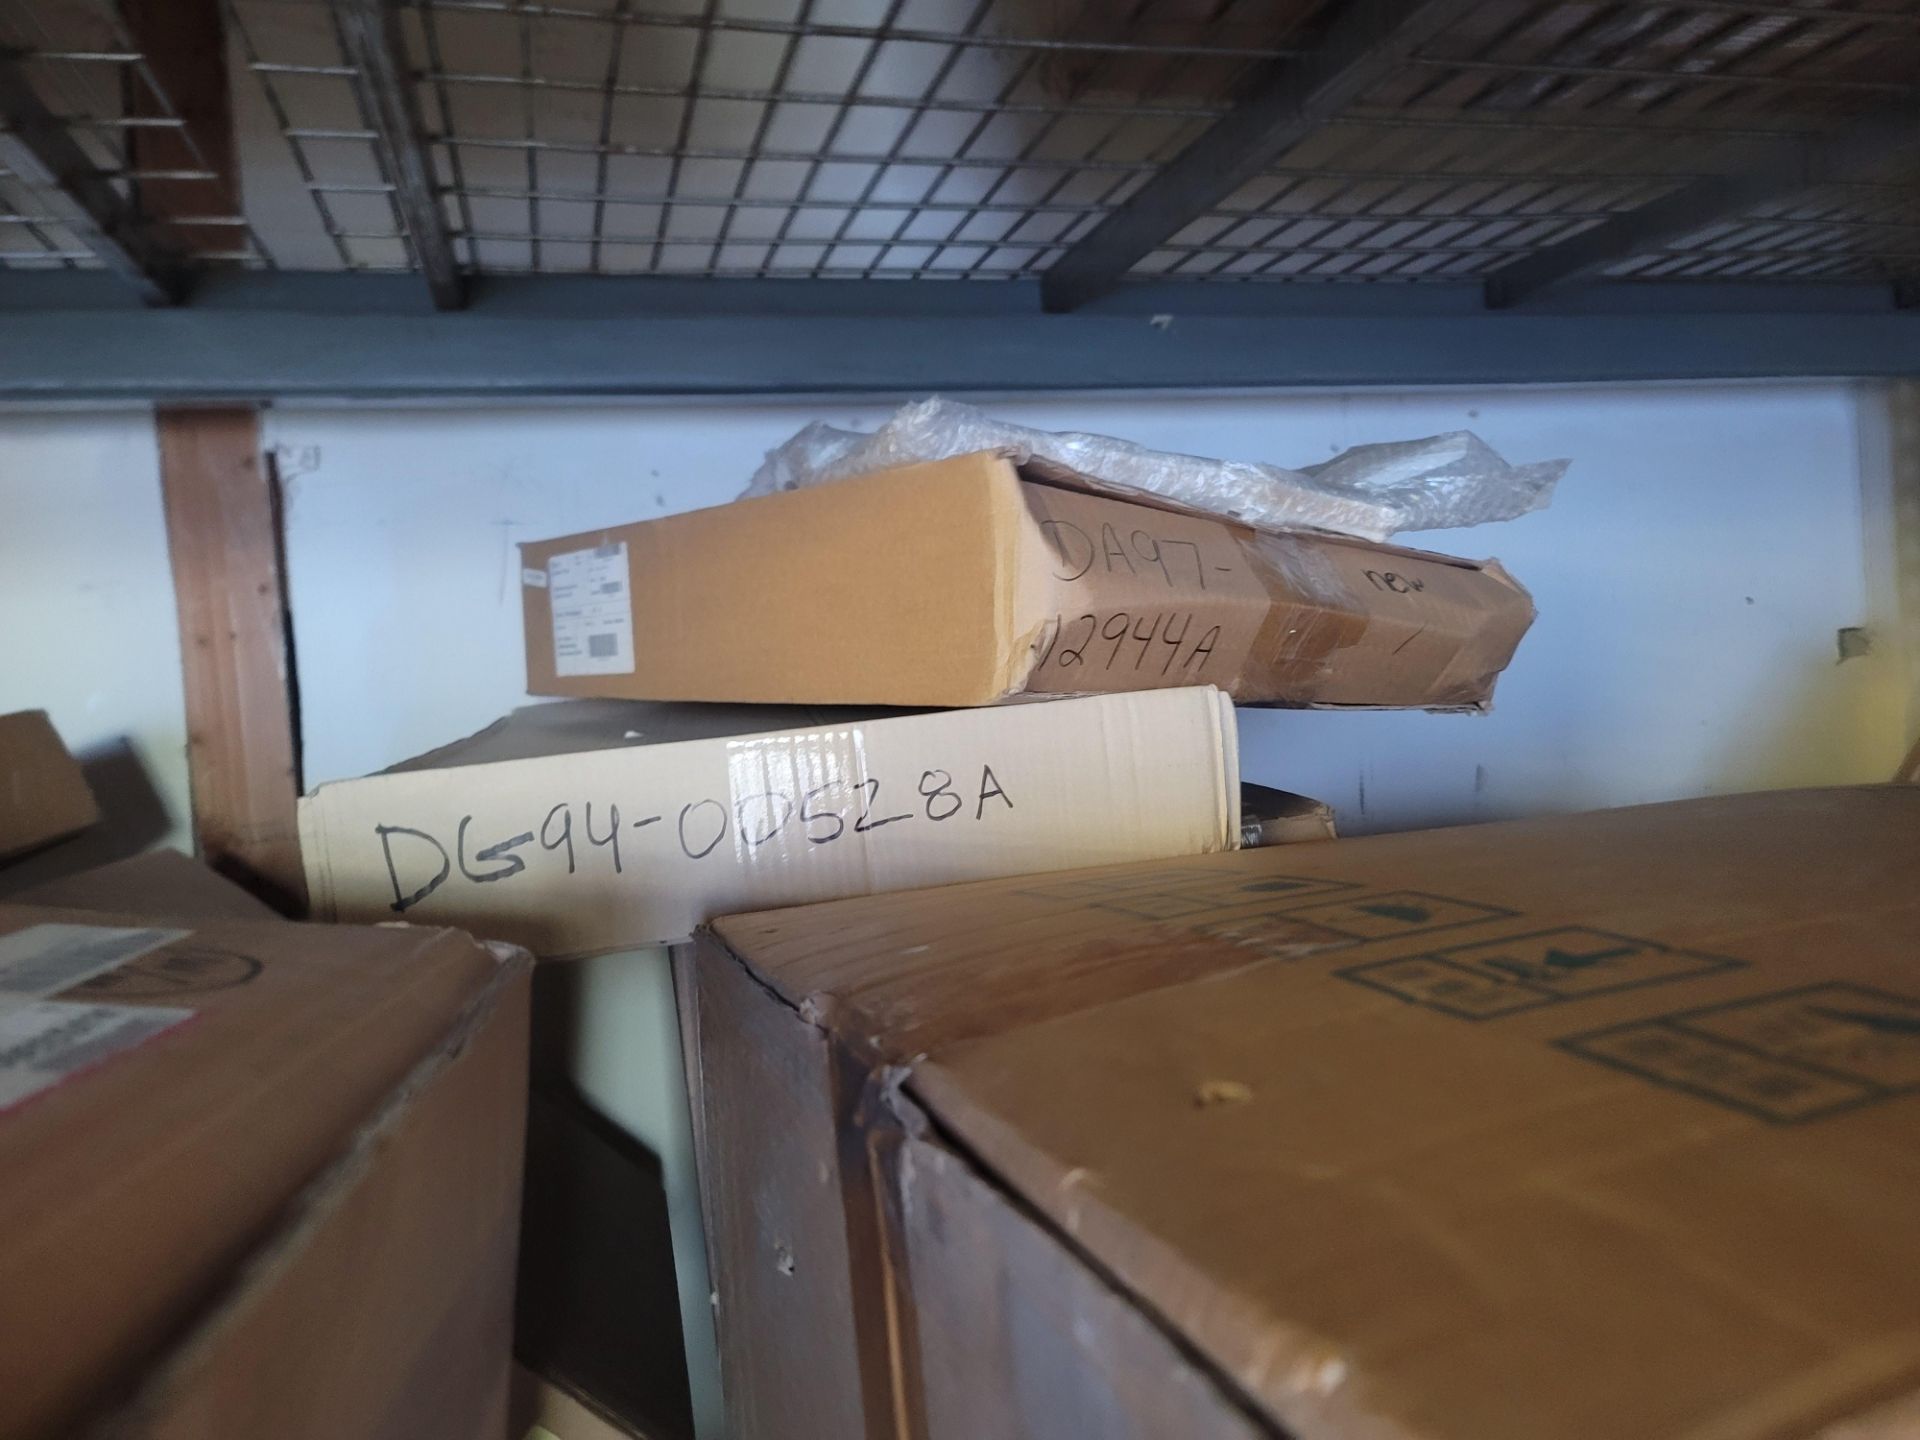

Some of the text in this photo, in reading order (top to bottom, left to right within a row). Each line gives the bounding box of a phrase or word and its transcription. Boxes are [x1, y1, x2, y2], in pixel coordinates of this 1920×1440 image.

[1040, 519, 1232, 590] DA97-
[1036, 612, 1221, 676] 12944A
[375, 764, 1014, 912] DG94-00528A
